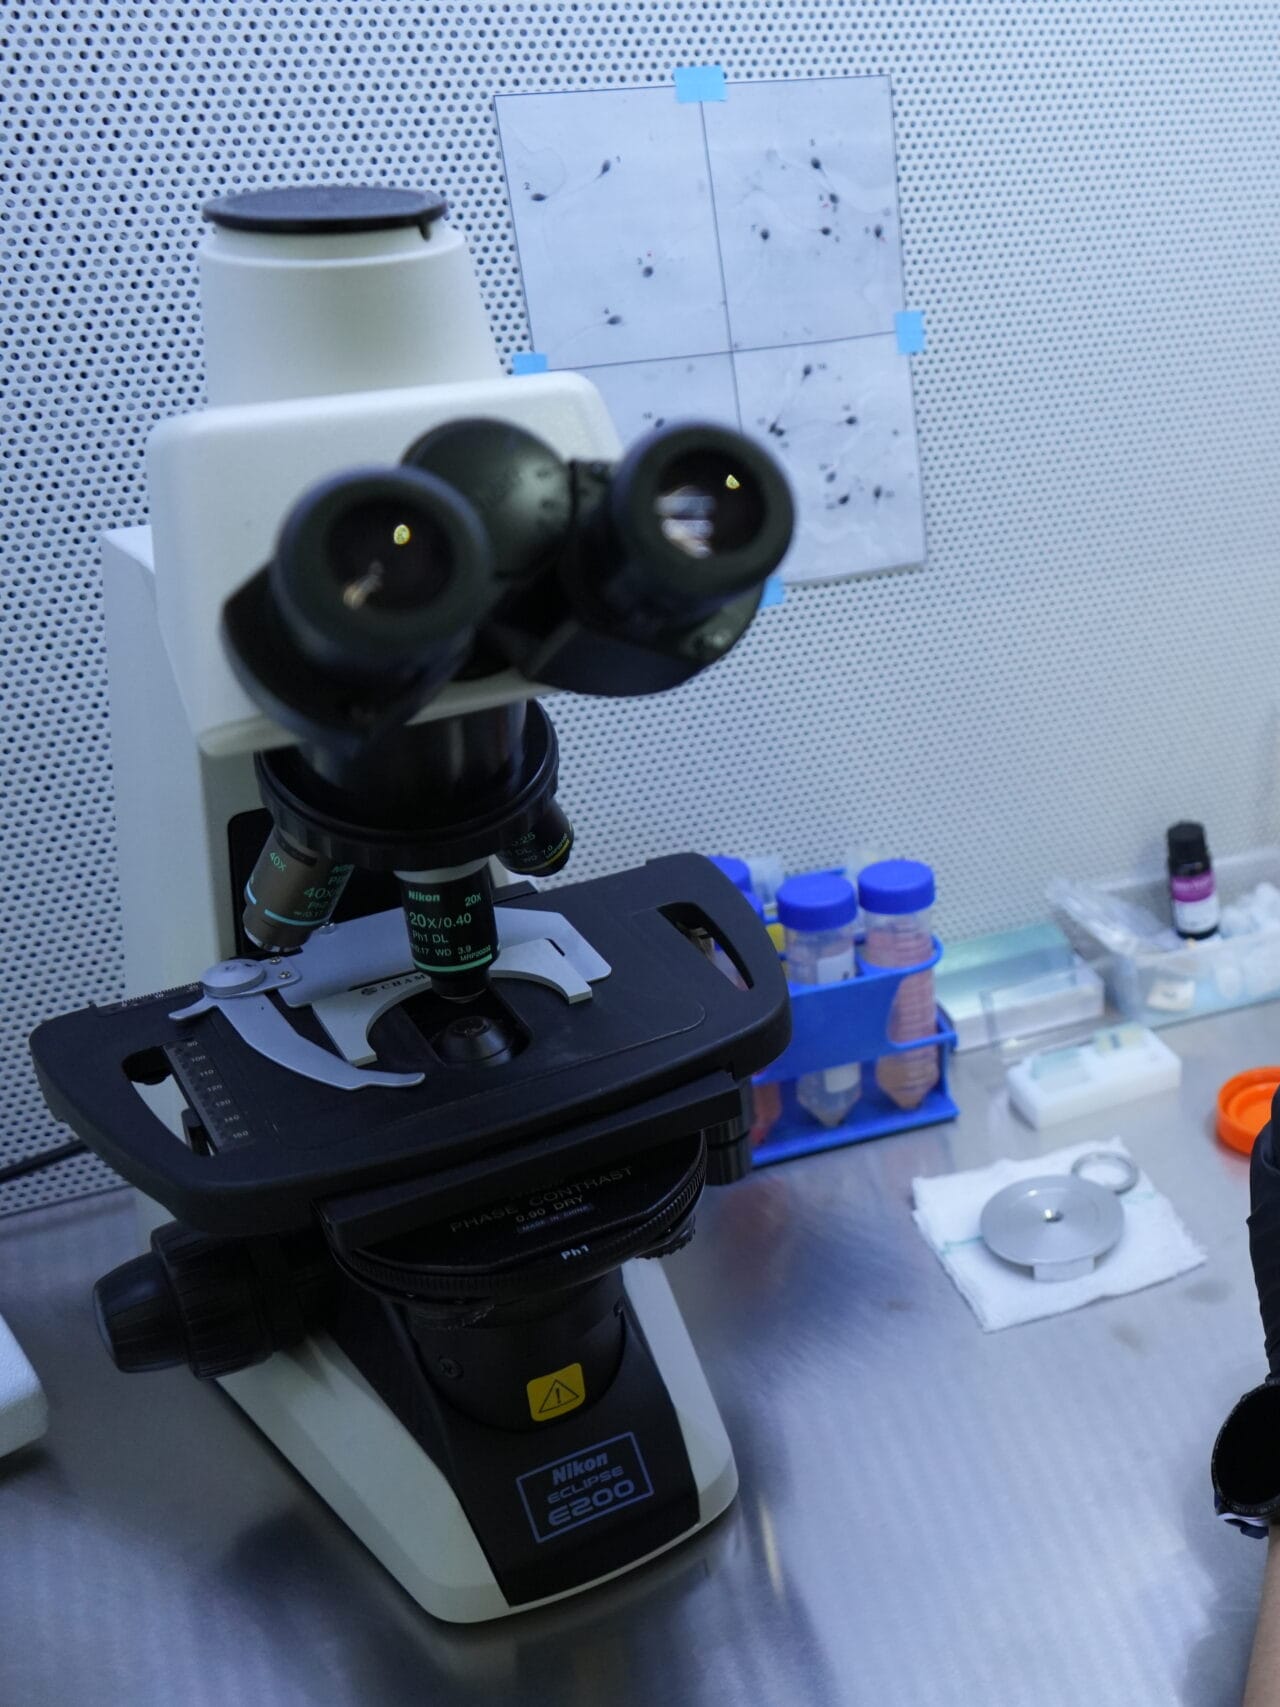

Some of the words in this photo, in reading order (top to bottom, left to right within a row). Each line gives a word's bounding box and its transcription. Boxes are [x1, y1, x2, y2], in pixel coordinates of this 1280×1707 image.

[407, 889, 441, 903] Nikon
[431, 933, 449, 944] DL
[434, 948, 452, 957] WD
[450, 1204, 519, 1233] PHASE
[529, 1165, 633, 1207] CONTRAST
[553, 1194, 585, 1211] DRY
[560, 1243, 590, 1261] Ph1
[552, 1452, 609, 1486] Nikon
[547, 1465, 625, 1504] ECLIPSE
[548, 1478, 636, 1526] E200
